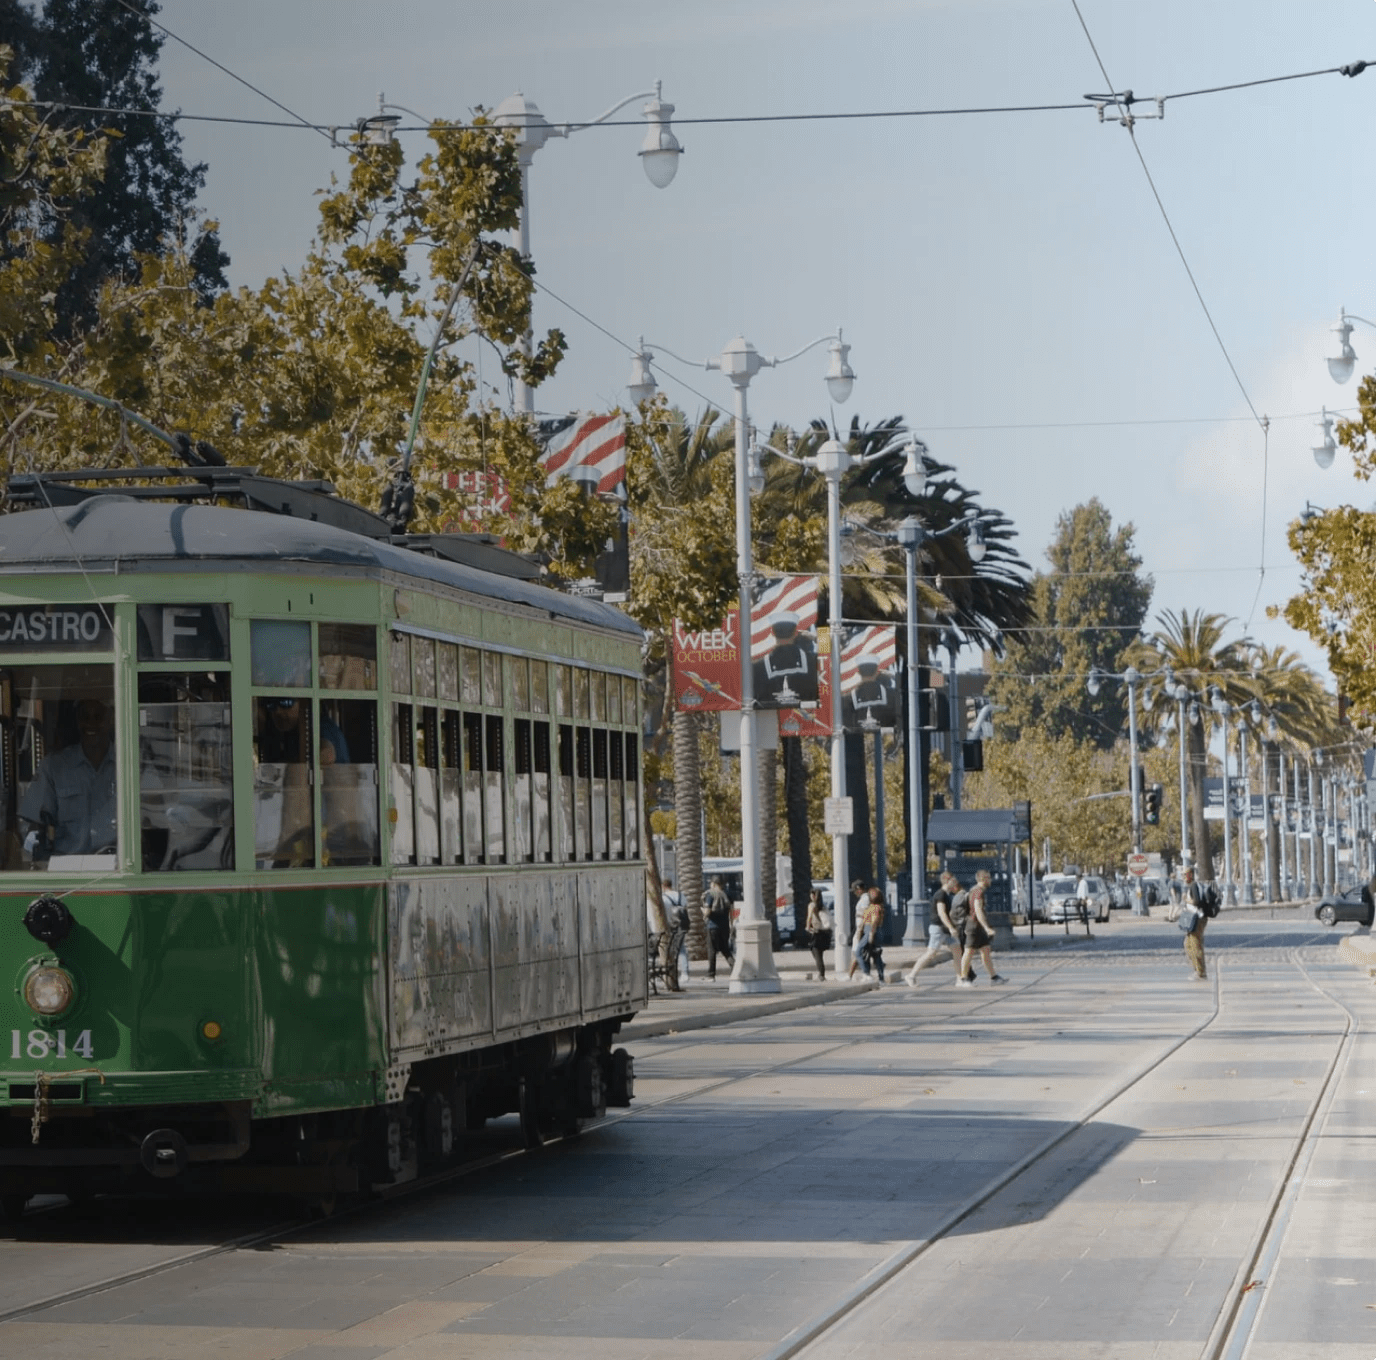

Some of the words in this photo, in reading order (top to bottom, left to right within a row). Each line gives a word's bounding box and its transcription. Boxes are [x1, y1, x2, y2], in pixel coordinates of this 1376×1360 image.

[162, 607, 202, 655] F
[676, 631, 736, 650] WEEK
[677, 649, 737, 663] OCTOBER
[11, 1029, 94, 1059] 1814
